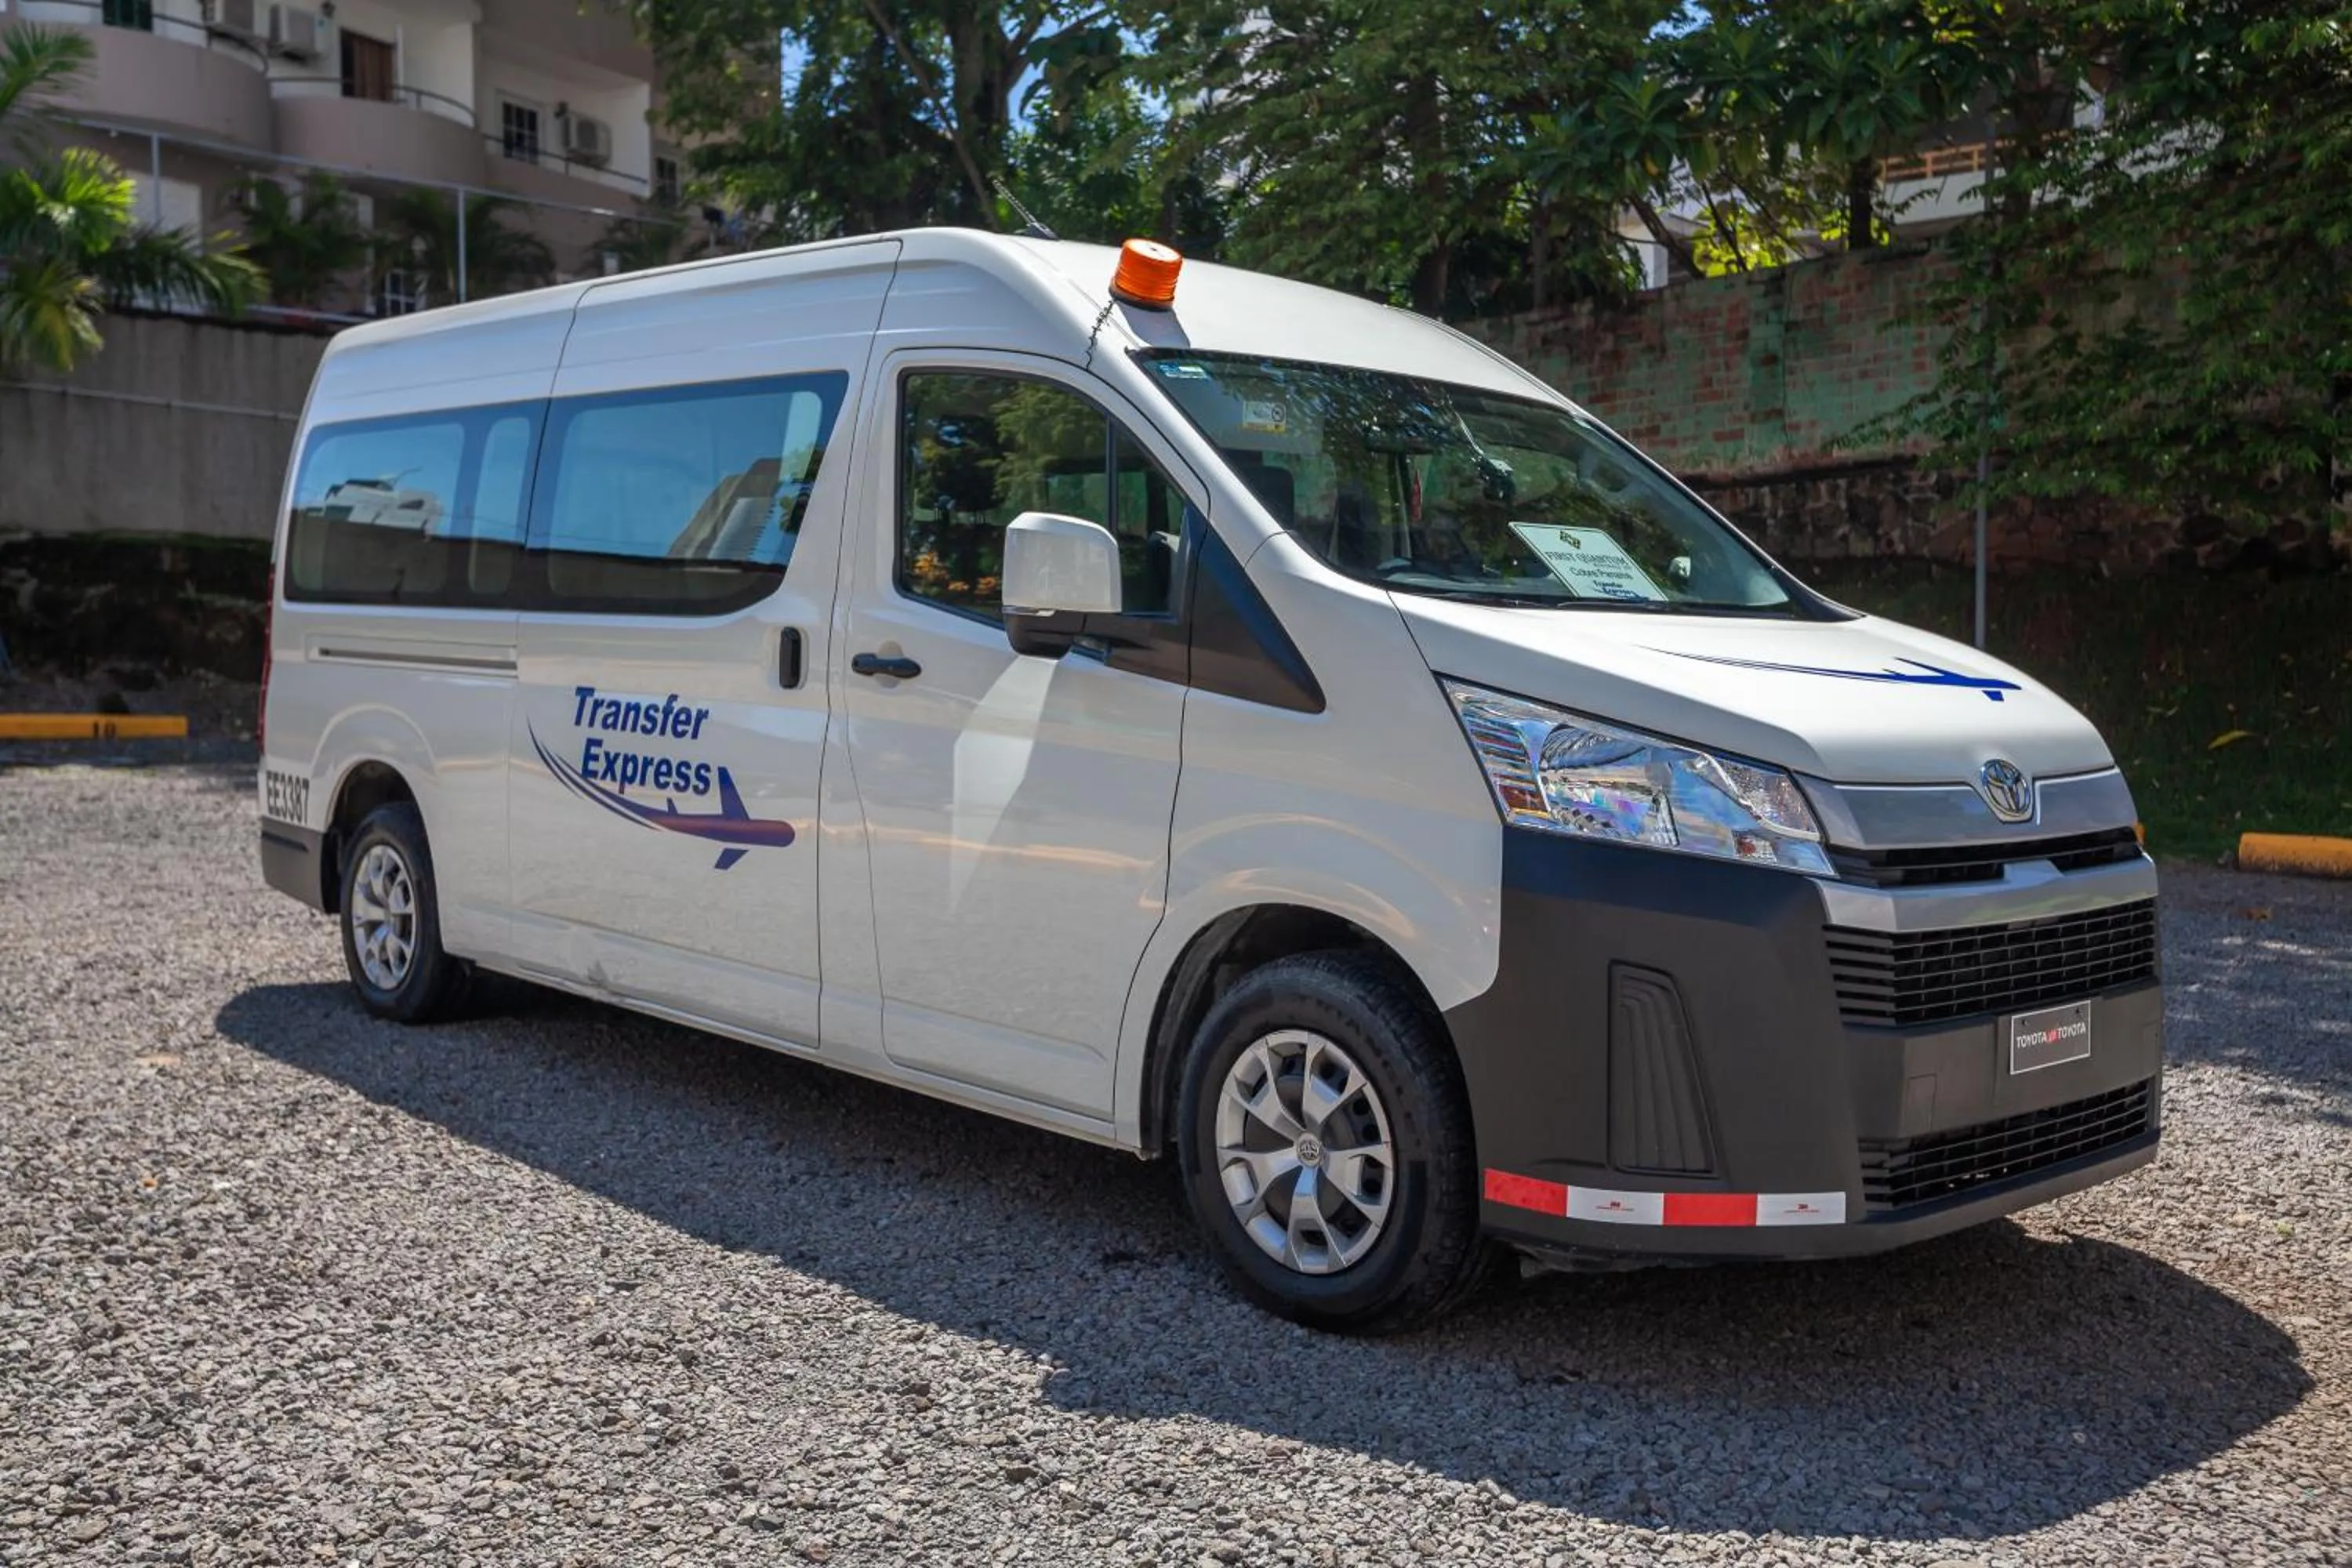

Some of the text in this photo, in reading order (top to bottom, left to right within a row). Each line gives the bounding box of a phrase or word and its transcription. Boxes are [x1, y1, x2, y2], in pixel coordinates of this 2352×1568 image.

[574, 686, 710, 740] Transfer
[581, 737, 712, 796] Express
[267, 770, 310, 824] EE3387
[2016, 1032, 2047, 1048] TOYOTA
[2056, 1022, 2086, 1040] TOYOTA
